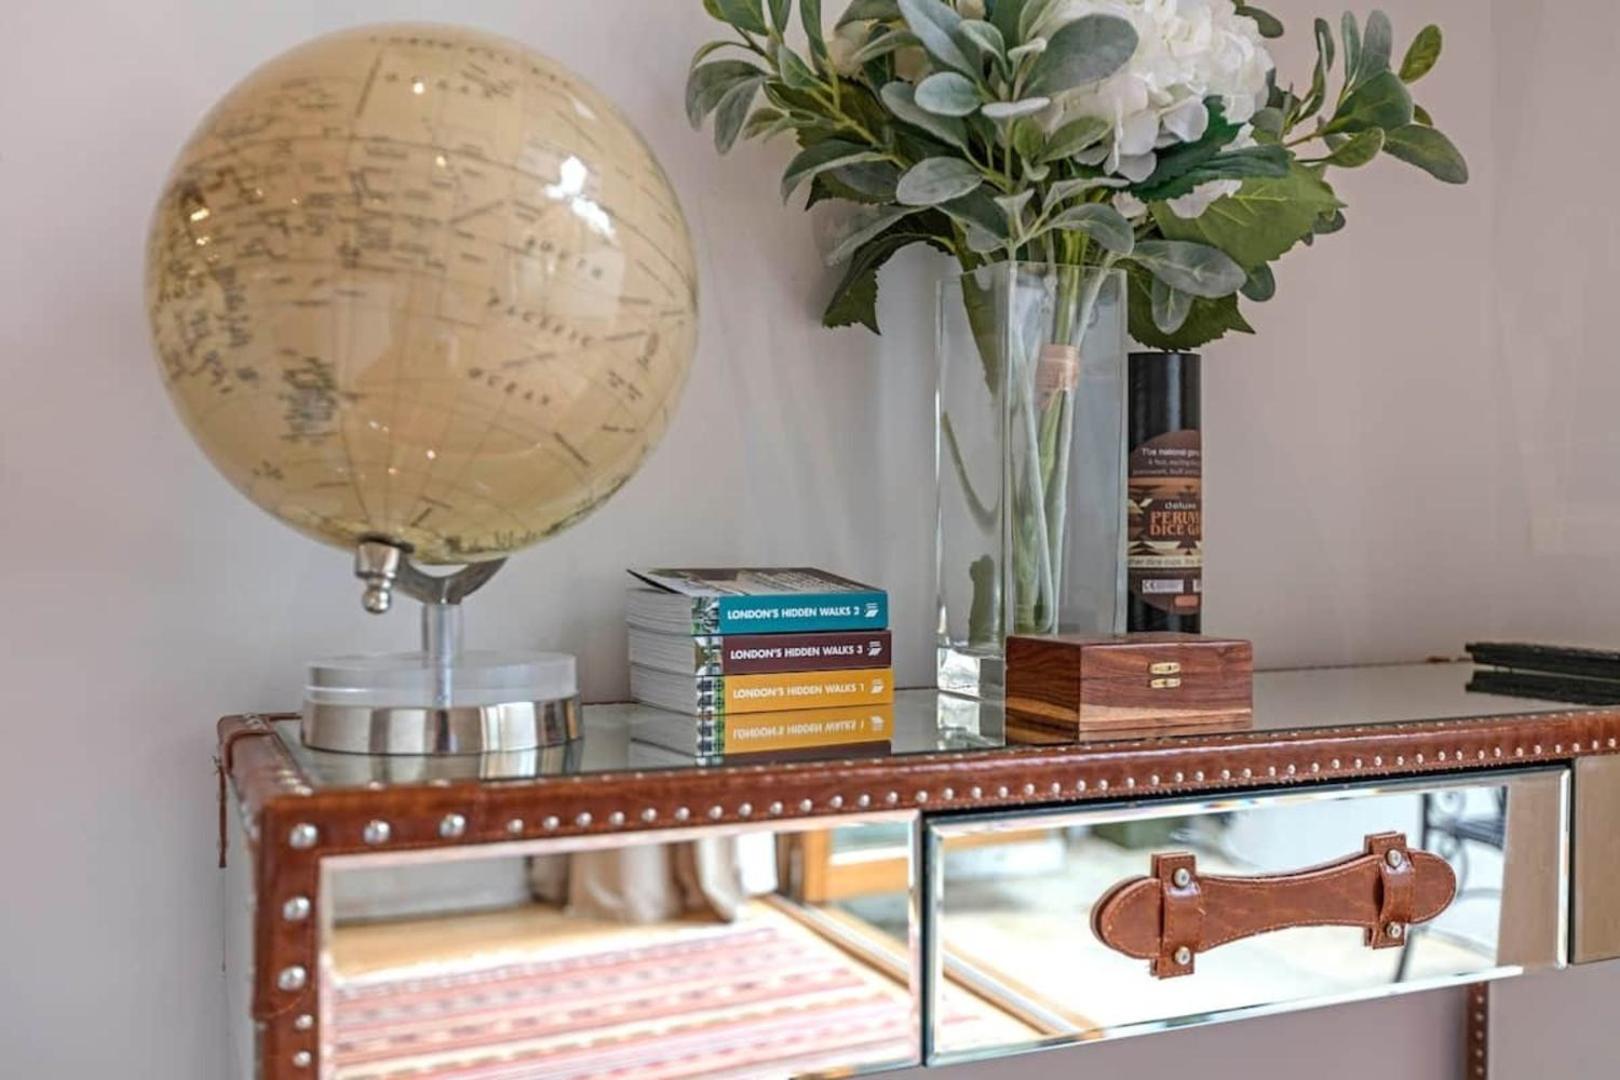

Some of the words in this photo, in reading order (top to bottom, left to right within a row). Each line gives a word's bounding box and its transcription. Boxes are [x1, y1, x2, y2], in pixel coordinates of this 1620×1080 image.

[1150, 524, 1185, 536] DICE
[727, 608, 779, 620] LONDON'S
[781, 606, 818, 618] HIDDEN
[820, 606, 851, 616] WALKS
[853, 606, 860, 615] 2
[730, 648, 782, 660] LONDON'S
[784, 646, 820, 658] HIDDEN
[823, 645, 854, 655] WALKS
[856, 645, 863, 654] 3
[733, 687, 785, 699] LONDON'S
[787, 685, 822, 697] HIDDEN
[825, 684, 857, 694] WALKS
[860, 684, 865, 692] 1
